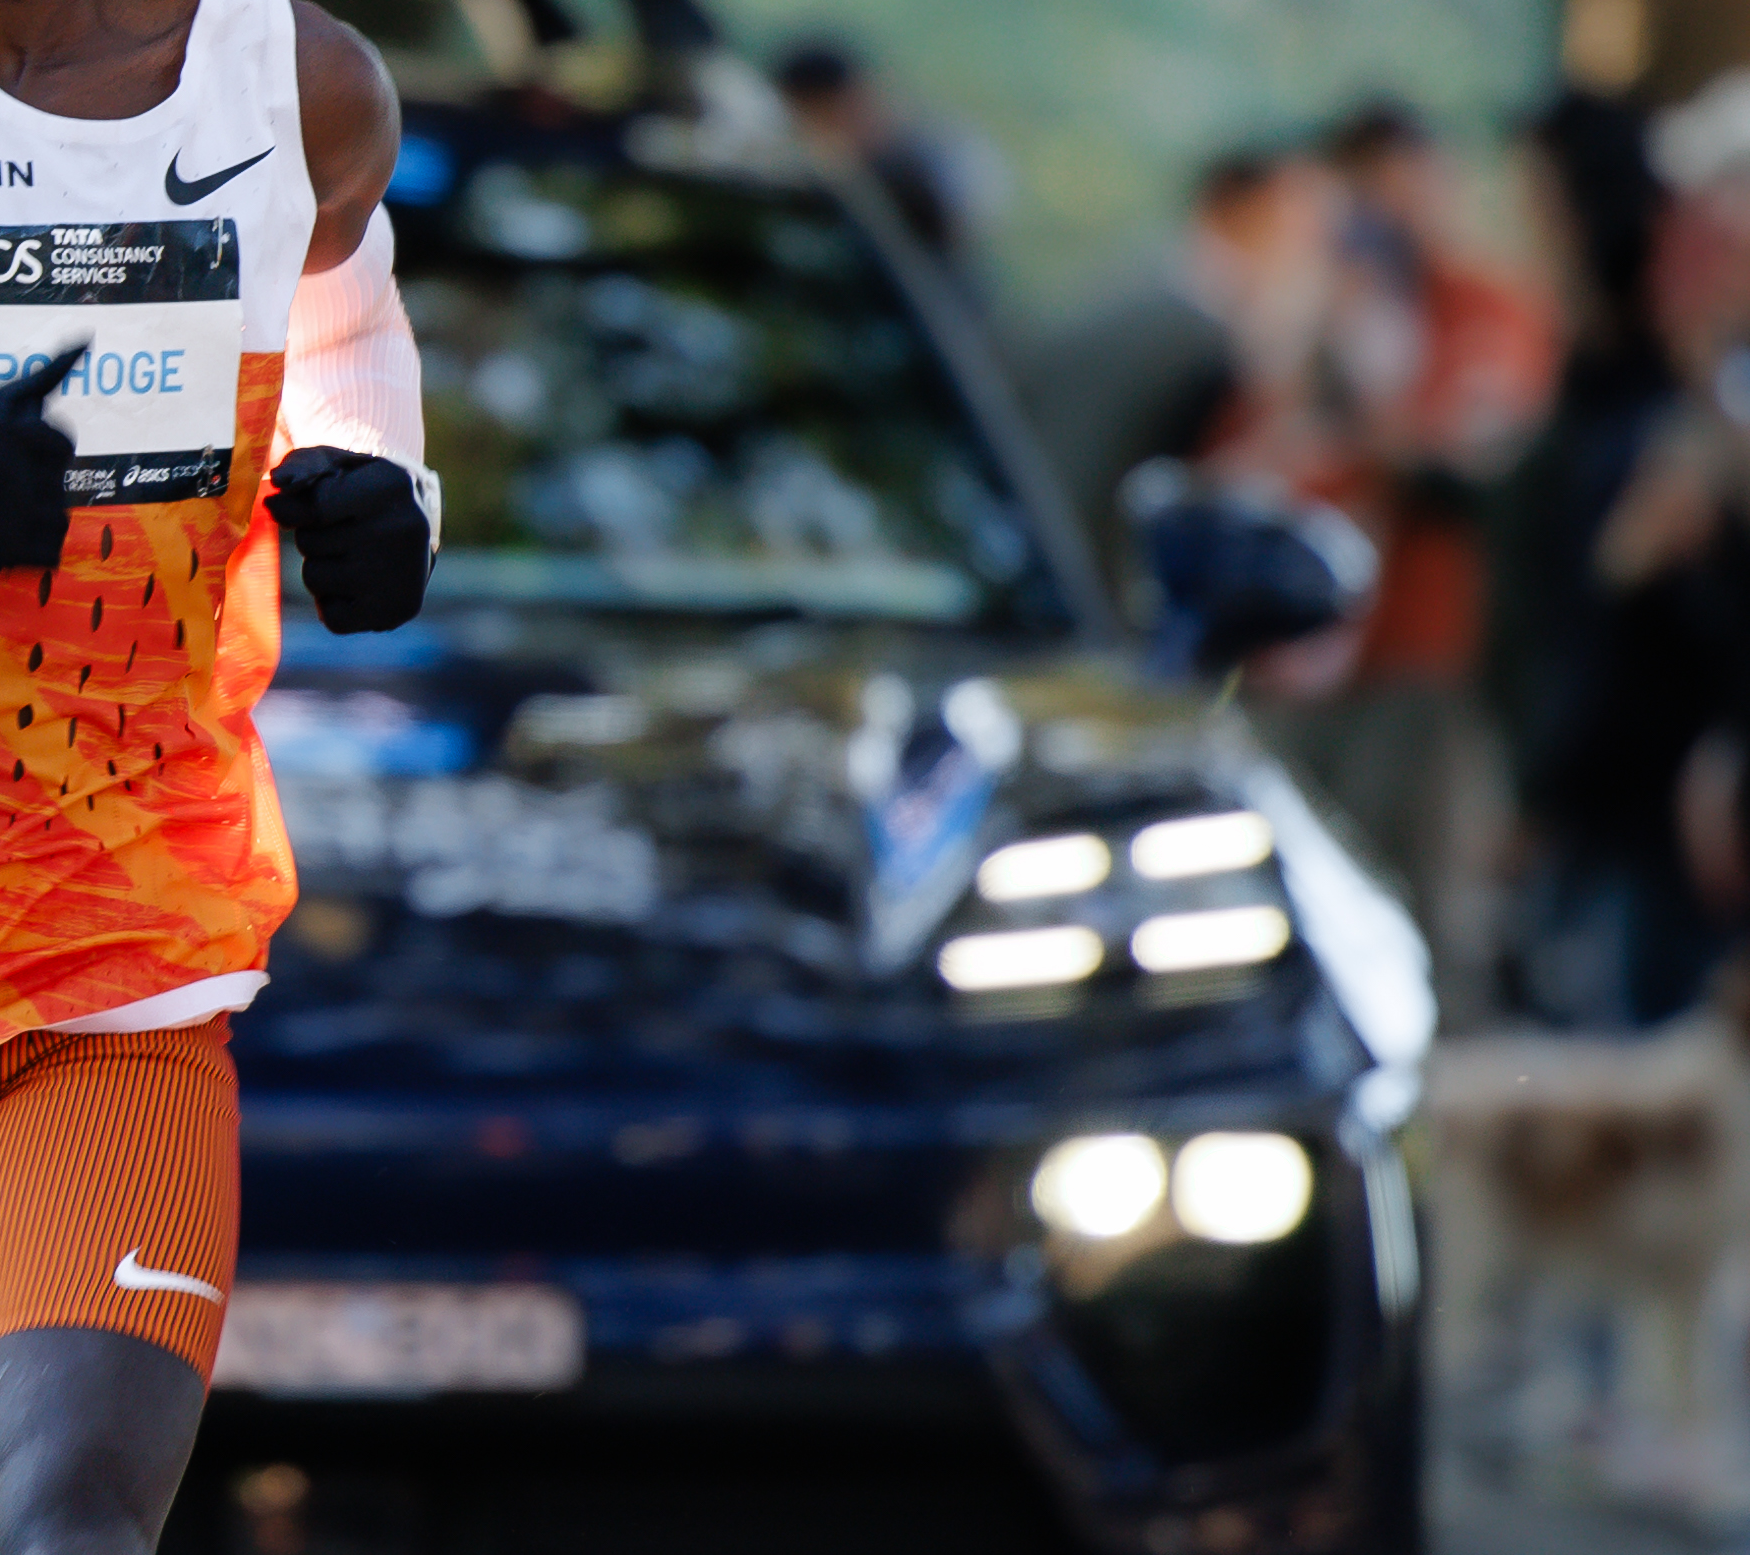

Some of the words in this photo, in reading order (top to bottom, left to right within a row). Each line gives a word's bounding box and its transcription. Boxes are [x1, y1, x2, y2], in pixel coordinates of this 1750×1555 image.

[51, 228, 103, 245] TATA
[51, 245, 165, 265] CONSULTANCY
[51, 266, 127, 284] SERVICES
